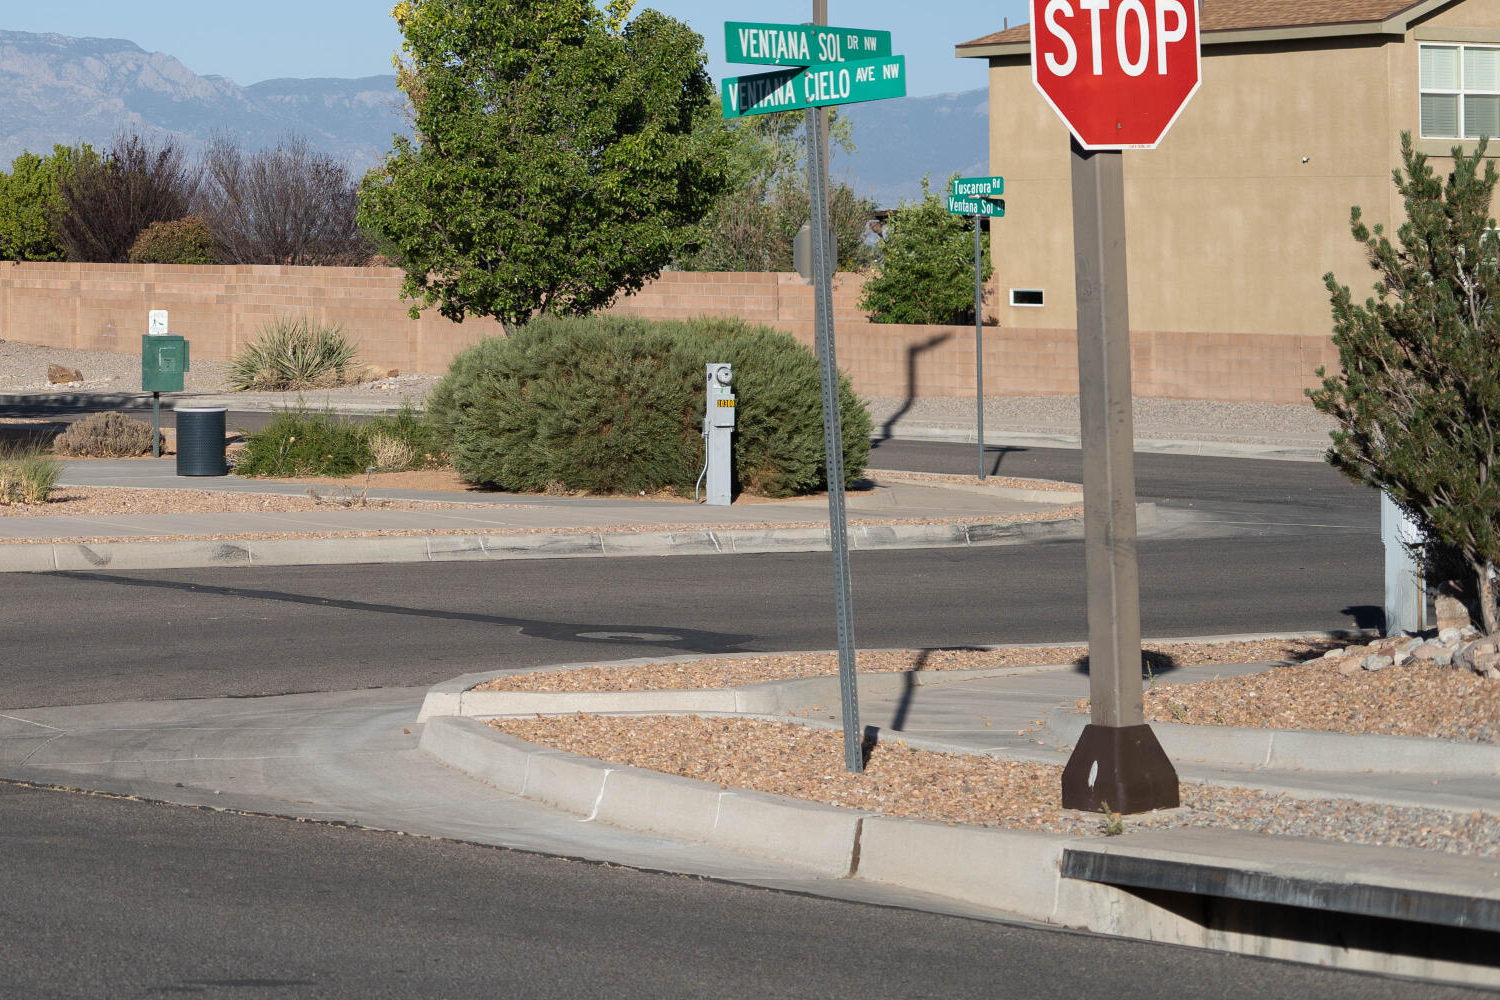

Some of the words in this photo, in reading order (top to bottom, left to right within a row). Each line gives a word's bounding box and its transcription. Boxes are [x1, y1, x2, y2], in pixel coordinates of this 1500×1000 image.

[738, 28, 810, 60] VENTANA
[818, 32, 845, 62] SOL
[847, 35, 859, 50] DR
[864, 36, 877, 51] NW
[728, 76, 796, 111] VENTANA
[804, 68, 850, 101] CIELO
[855, 65, 875, 82] AVE
[883, 63, 899, 80] NW
[954, 180, 991, 195] Tuscarora
[992, 178, 1001, 188] Rd
[948, 197, 977, 213] Ventana
[981, 200, 993, 214] Sol
